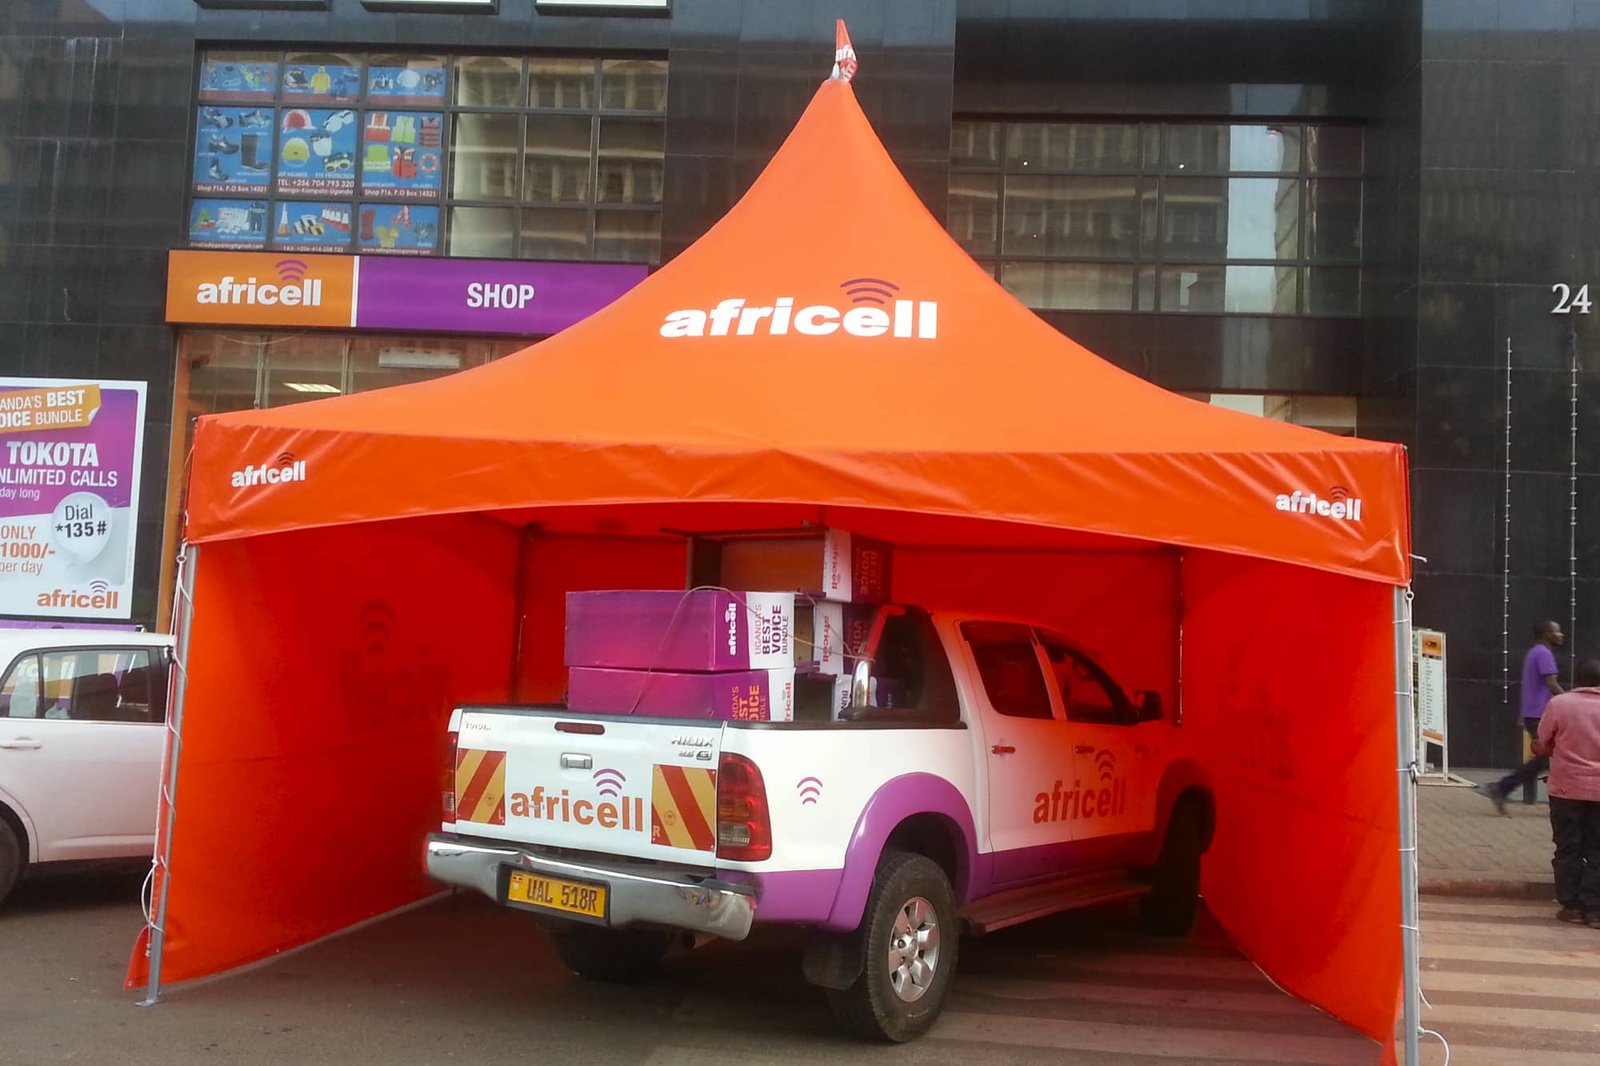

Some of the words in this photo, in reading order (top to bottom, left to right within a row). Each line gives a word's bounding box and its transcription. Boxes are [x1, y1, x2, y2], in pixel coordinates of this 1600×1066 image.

[197, 184, 212, 192] Shop
[293, 179, 310, 188] +256
[312, 179, 325, 188] 704
[326, 180, 340, 188] 793
[341, 180, 355, 188] 320
[365, 188, 380, 197] Shop
[197, 276, 321, 306] africell
[467, 282, 535, 309] SHOP
[1551, 283, 1593, 314] 24
[659, 297, 937, 339] africell
[47, 389, 85, 407] BEST
[36, 408, 83, 425] BUNDLE
[7, 440, 99, 467] TOKOTA
[70, 470, 118, 488] CALLS
[231, 460, 306, 487] africell
[0, 486, 17, 500] day
[19, 487, 40, 501] long
[1276, 490, 1361, 521] africell
[65, 504, 93, 520] Dial
[1, 525, 36, 540] ONLY
[21, 561, 43, 576] day
[860, 550, 870, 596] VOICE
[37, 590, 119, 610] africell
[728, 602, 737, 656] africell
[754, 604, 762, 655] UGANDA'S
[762, 616, 771, 655] BEST
[772, 604, 782, 655] VOICE
[510, 785, 644, 832] africell
[1033, 777, 1127, 824] africell
[653, 825, 661, 837] R
[527, 878, 553, 904] UAL
[561, 884, 598, 912] 518R
